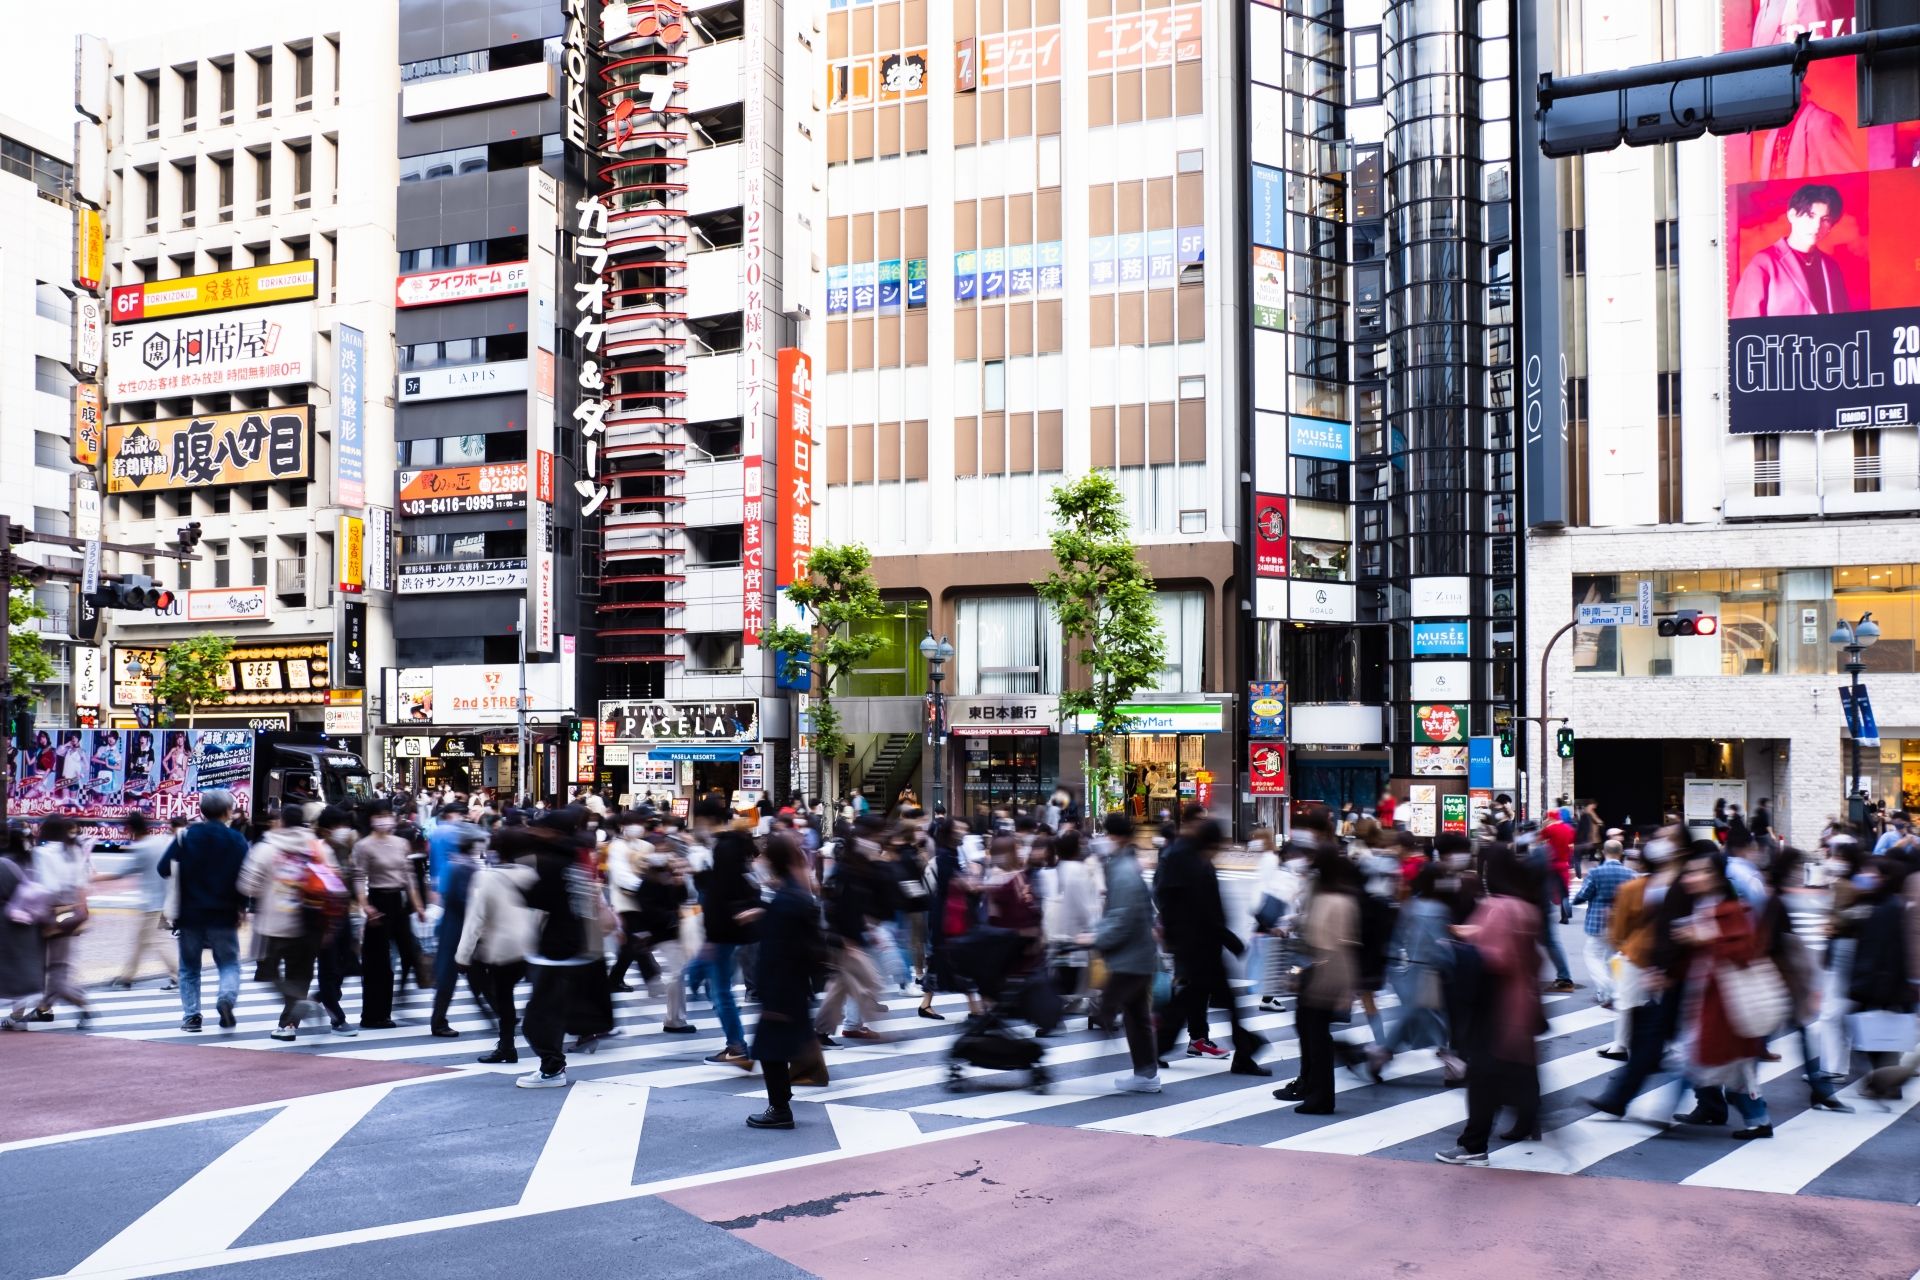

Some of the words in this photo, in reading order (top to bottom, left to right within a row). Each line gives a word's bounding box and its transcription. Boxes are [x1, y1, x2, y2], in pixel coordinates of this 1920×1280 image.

[984, 33, 1061, 71] ジェイ
[1104, 13, 1193, 56] エステ
[429, 270, 502, 291] アイワホーム
[508, 269, 524, 281] 6F
[1259, 284, 1279, 295] Milan
[117, 292, 140, 313] 6F
[1256, 290, 1282, 306] Nataraj
[1261, 312, 1277, 328] 3F
[112, 330, 133, 348] 5F
[171, 318, 269, 368] 相席屋
[82, 364, 96, 374] 5F
[1736, 330, 1884, 392] Gifted.
[117, 375, 178, 395] 女性のお客様
[181, 368, 223, 389] 飲み放題
[226, 362, 301, 382] 時間無制限0円
[448, 370, 496, 385] LAPIS
[341, 347, 357, 441] 渋谷整形
[406, 380, 418, 392] 5F
[1879, 408, 1902, 420] B-ME
[76, 407, 99, 452] 腹八分目
[1297, 426, 1342, 444] MUSÉE
[120, 434, 160, 455] 伝説の
[169, 413, 304, 485] 腹八分目
[1297, 438, 1343, 450] PLATINUM
[81, 478, 94, 490] 3F
[110, 479, 124, 492] 4F
[793, 402, 812, 582] 東日本銀行
[412, 495, 494, 514] 03-6416-0995
[744, 500, 762, 636] 朝まで営業中
[1259, 556, 1284, 565] 年中無休
[1257, 564, 1286, 574] 24時間営業
[402, 573, 516, 590] 渋谷サンクスクリニック
[1435, 591, 1462, 600] Zina
[1310, 606, 1334, 615] GOALD
[1582, 606, 1632, 617] 神南一丁目
[1590, 616, 1614, 624] Jinnan
[1416, 629, 1464, 640] MUSÉE
[454, 697, 478, 709] 2nd
[482, 696, 534, 708] STRET
[968, 706, 1036, 720] 東日本銀行
[262, 719, 286, 730] PSFA
[626, 716, 726, 736] PASELA
